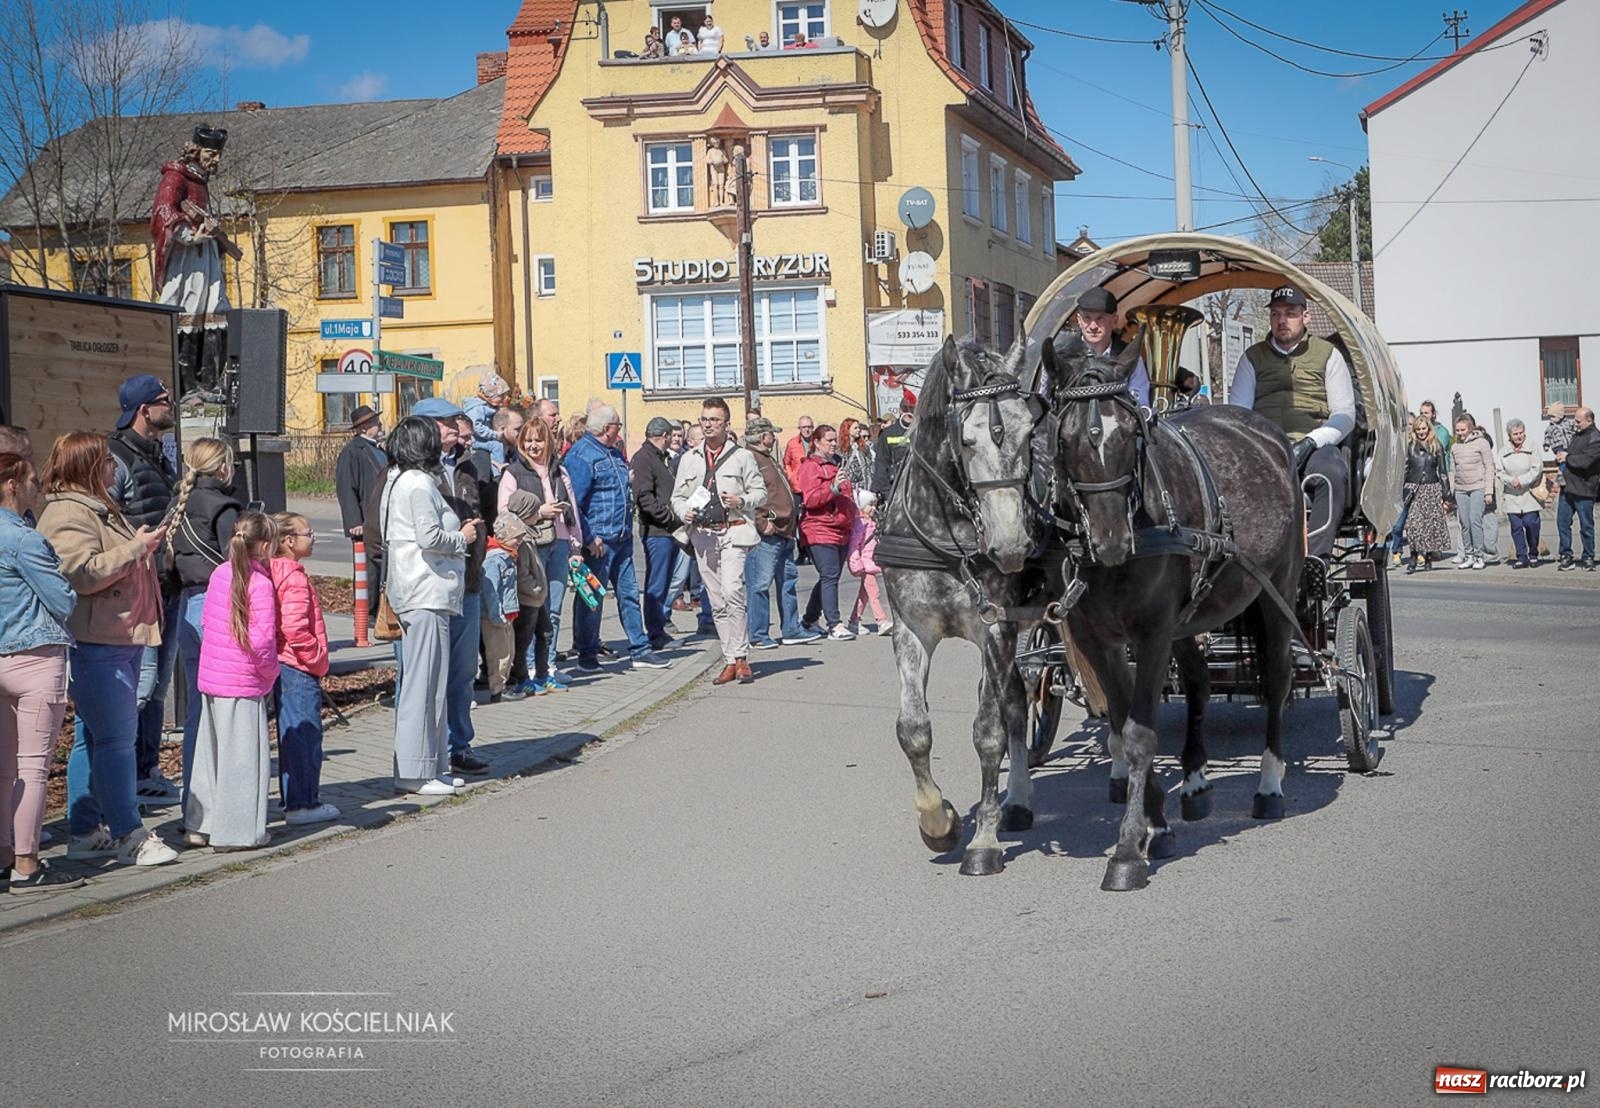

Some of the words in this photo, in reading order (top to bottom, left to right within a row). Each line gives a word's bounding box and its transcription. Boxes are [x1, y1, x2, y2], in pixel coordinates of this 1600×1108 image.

[736, 253, 830, 278] RYZUR
[1274, 287, 1294, 298] NYC
[344, 359, 372, 373] 40
